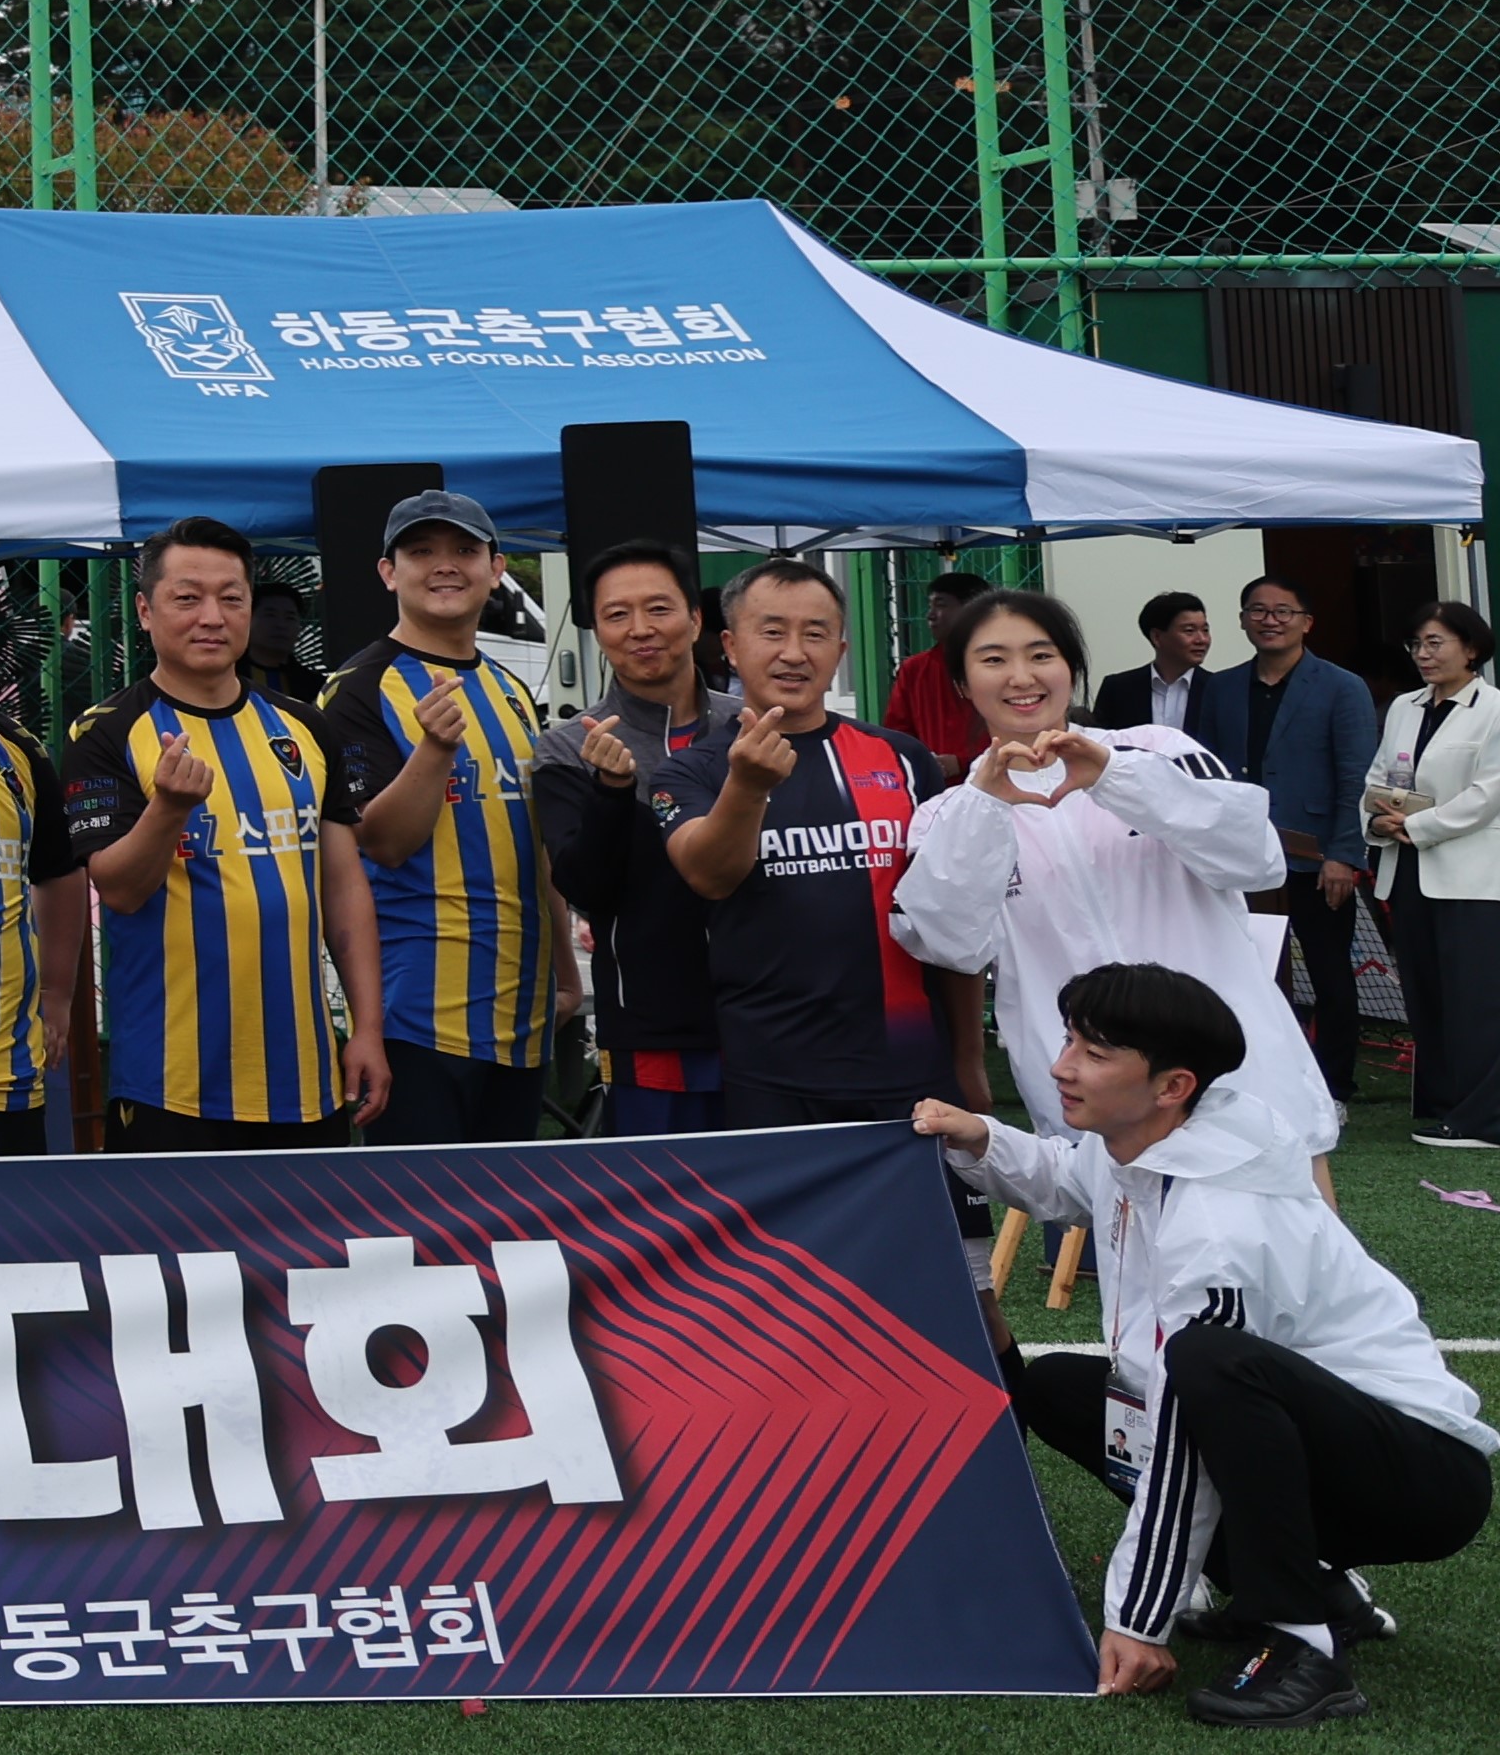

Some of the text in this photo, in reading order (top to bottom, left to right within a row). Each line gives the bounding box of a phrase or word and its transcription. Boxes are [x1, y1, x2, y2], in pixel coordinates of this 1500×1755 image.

[270, 303, 754, 351] 하동군축구협회
[299, 347, 767, 371] HADONG FOOTBALL ASSOCIATION
[196, 382, 270, 398] HFA
[757, 819, 906, 859] ANWOOL
[764, 853, 892, 877] FOOTBALL CLUB
